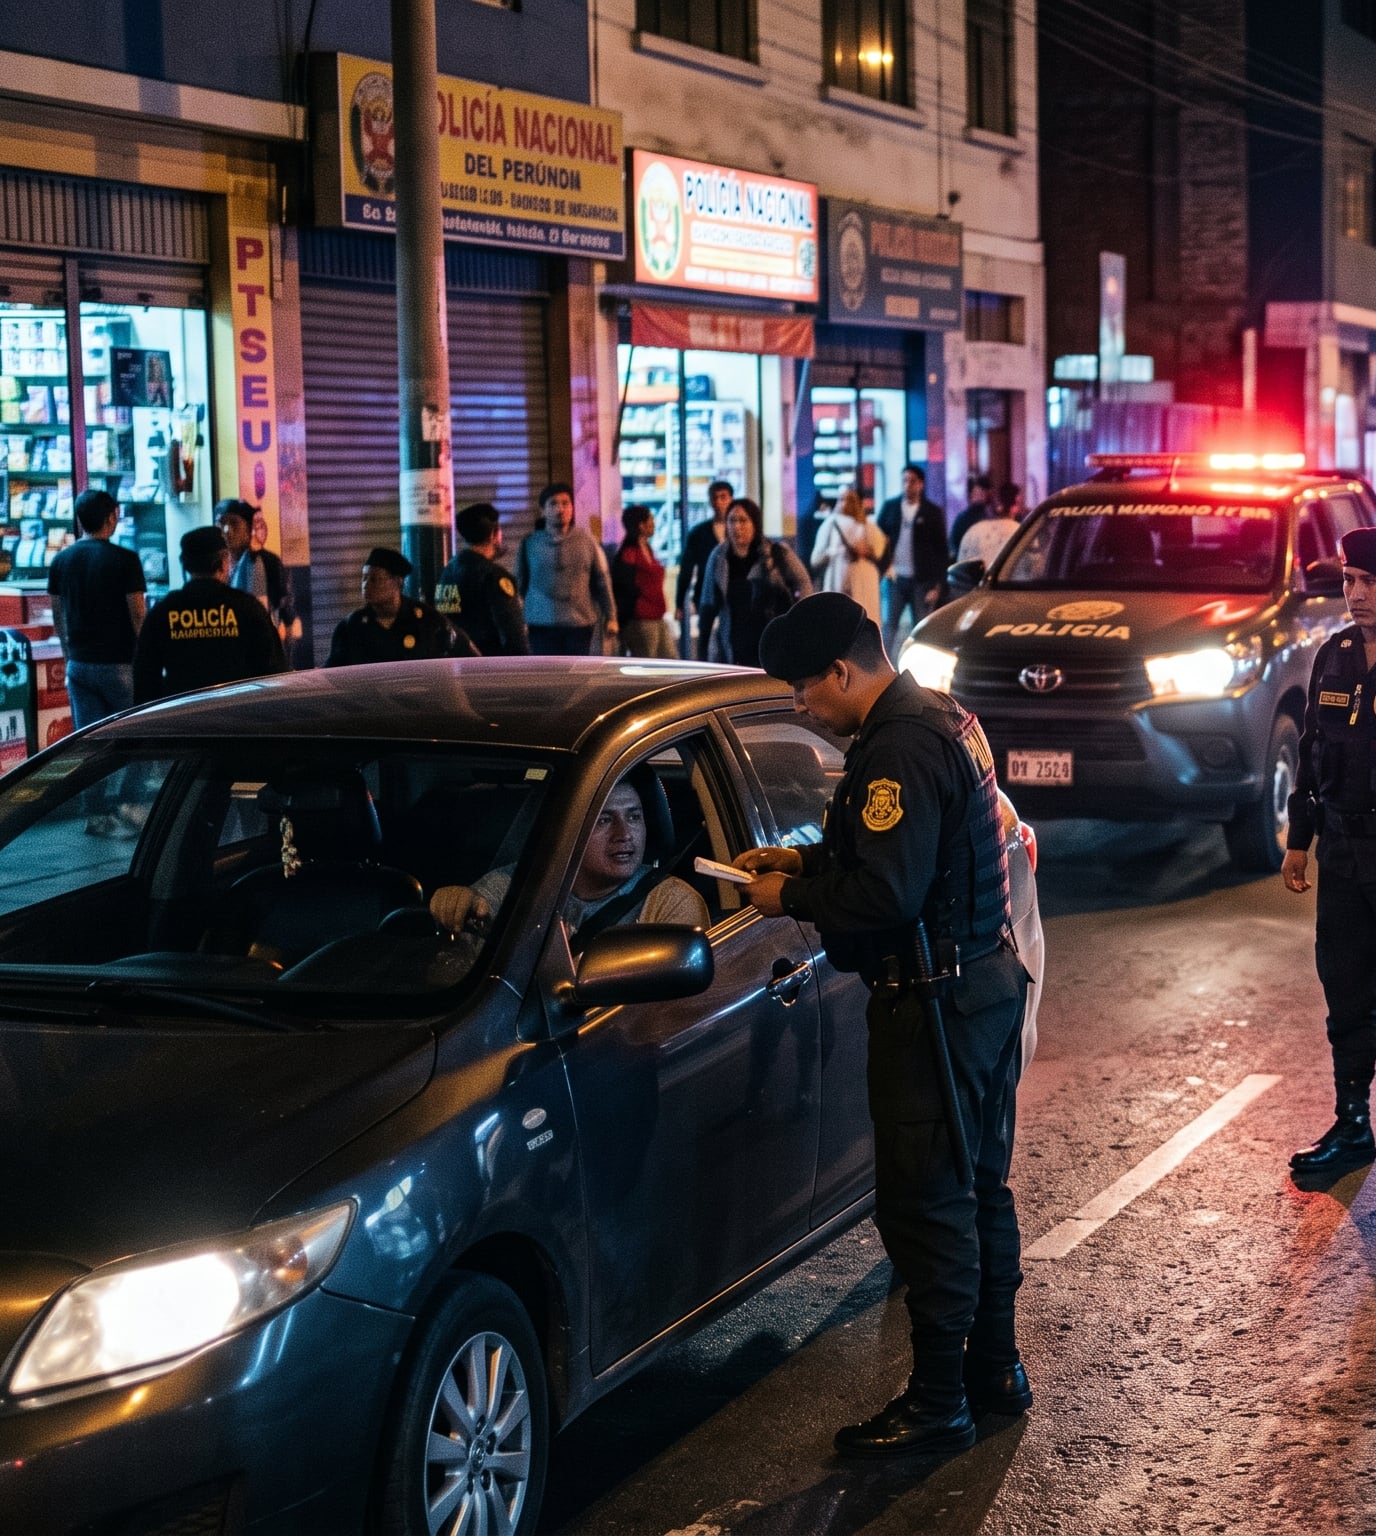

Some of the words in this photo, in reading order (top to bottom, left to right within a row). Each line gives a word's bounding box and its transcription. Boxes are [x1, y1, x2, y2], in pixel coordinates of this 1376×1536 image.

[436, 89, 508, 147] OLICÍA
[513, 106, 618, 165] NACIONAL
[464, 152, 498, 179] DEL
[168, 604, 238, 630] POLICÍA
[984, 623, 1130, 639] POLICIA
